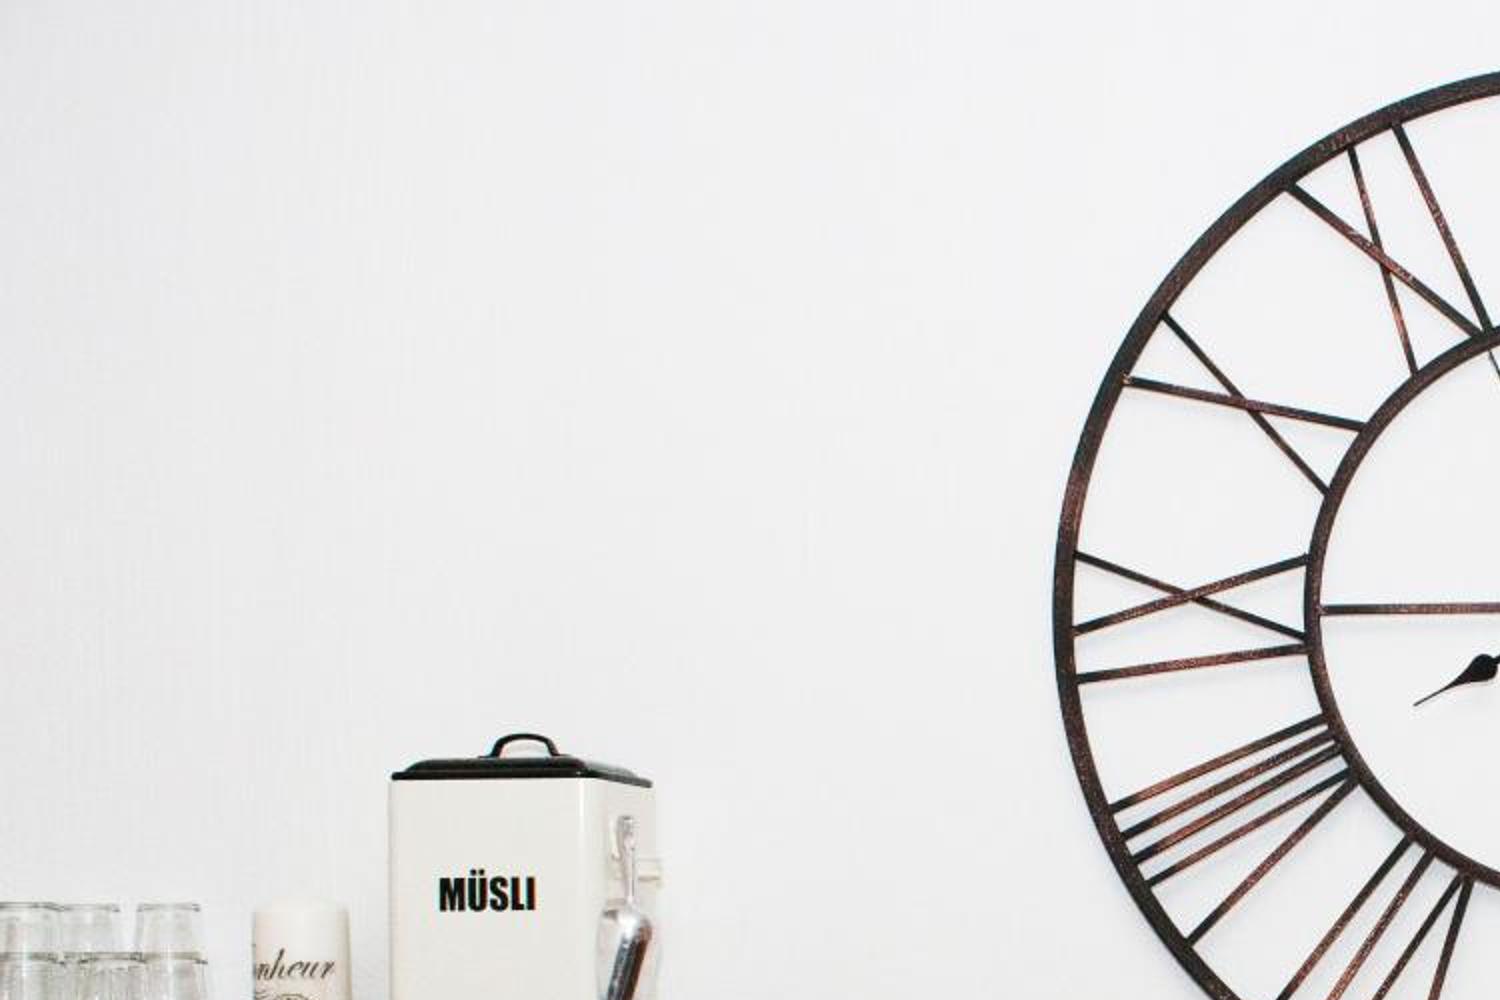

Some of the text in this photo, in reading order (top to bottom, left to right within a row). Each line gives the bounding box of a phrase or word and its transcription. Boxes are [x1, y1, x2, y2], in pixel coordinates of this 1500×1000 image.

[1285, 122, 1492, 376] XI
[1124, 312, 1367, 497] X
[1072, 549, 1310, 685] IX
[438, 868, 537, 912] MÜSLI
[1110, 713, 1360, 945] VIII
[254, 948, 335, 981] nheur
